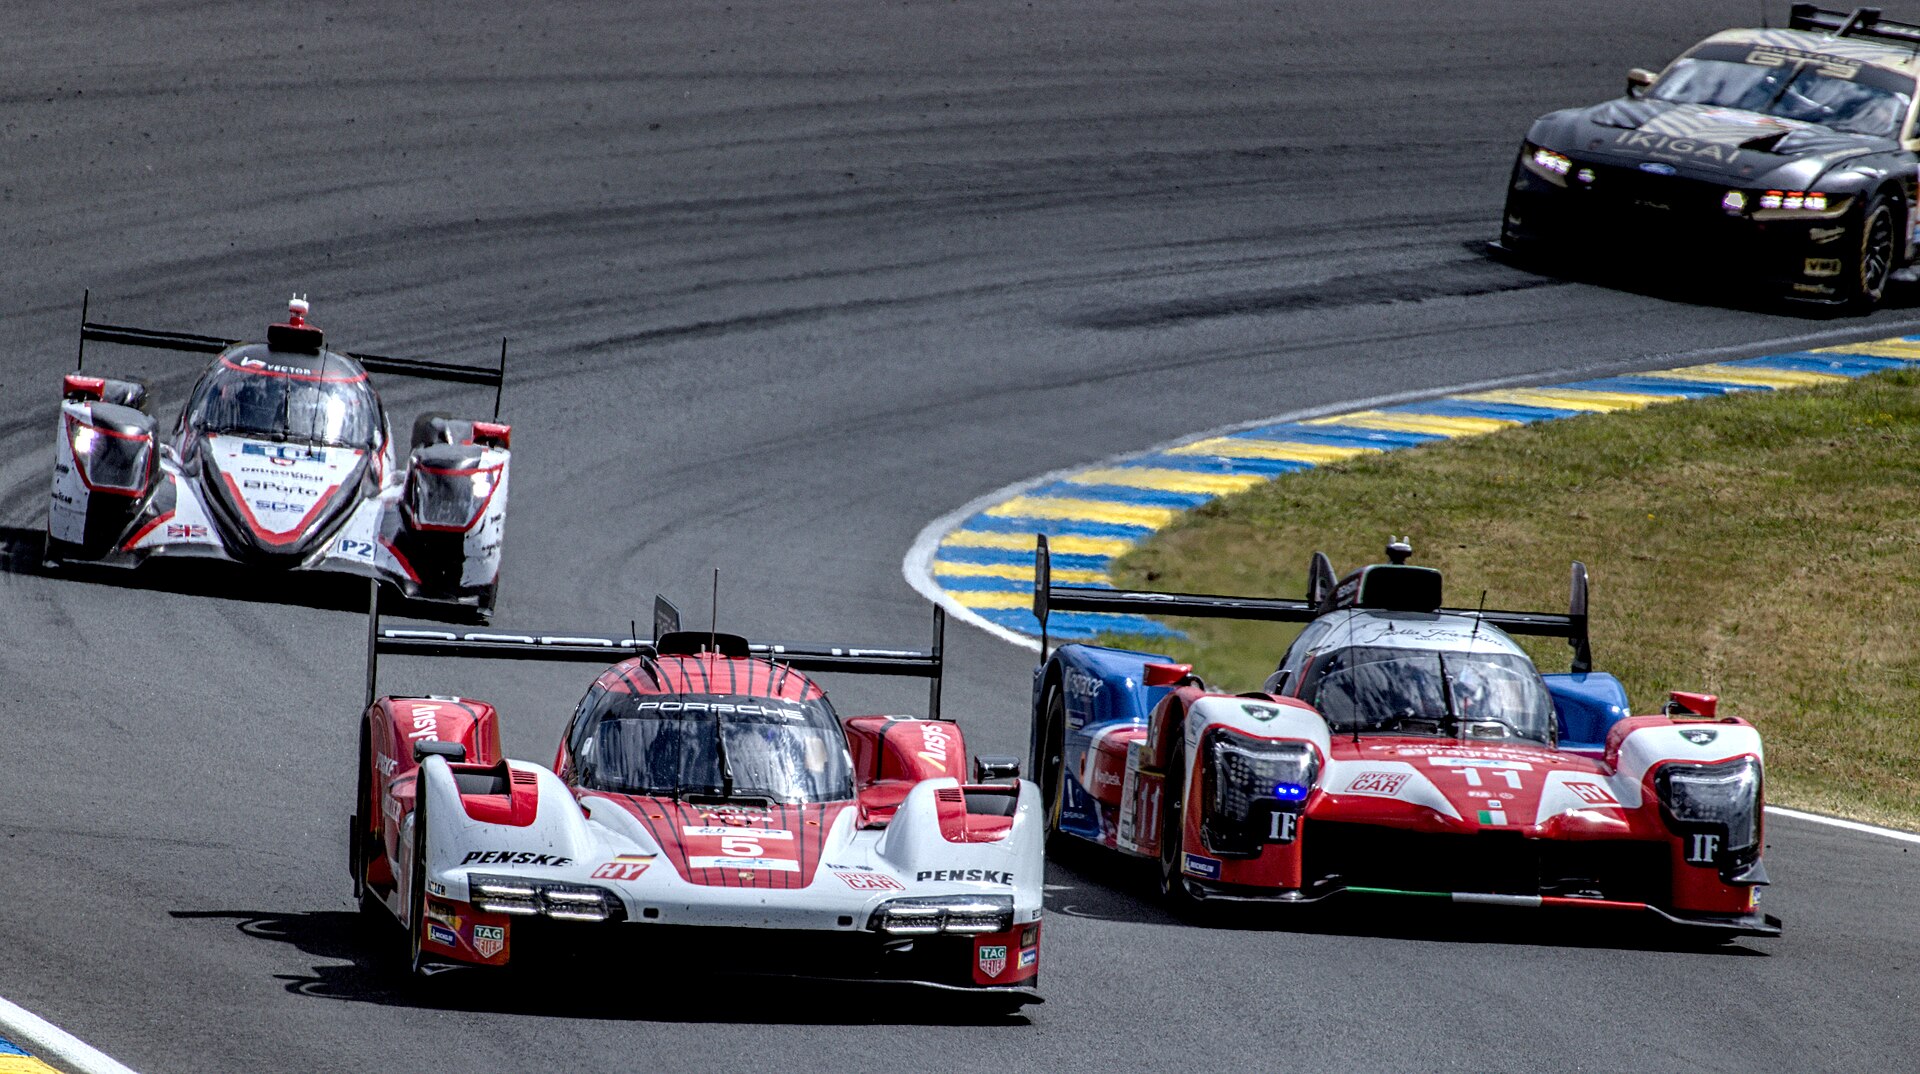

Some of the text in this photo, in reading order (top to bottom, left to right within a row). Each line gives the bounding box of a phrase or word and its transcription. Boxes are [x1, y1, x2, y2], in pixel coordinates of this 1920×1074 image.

[1614, 131, 1741, 165] IKIGAI
[267, 364, 311, 376] VECTOR
[342, 540, 371, 557] P2
[637, 702, 805, 721] PORSCHE
[919, 724, 952, 773] Ansys
[1364, 772, 1406, 782] HYPER
[1450, 767, 1521, 789] 11
[1351, 780, 1399, 794] CAR
[1572, 784, 1609, 801] HY
[1139, 782, 1162, 842] 11
[721, 836, 764, 857] 5
[1692, 834, 1720, 862] IF
[460, 851, 574, 867] PENSKE
[599, 864, 644, 879] HY
[917, 870, 1014, 885] PENSKE
[848, 879, 899, 889] CAR
[476, 928, 502, 939] TAG
[474, 938, 503, 955] HEUER
[982, 949, 1006, 959] TAG
[979, 958, 1006, 973] HEUER
